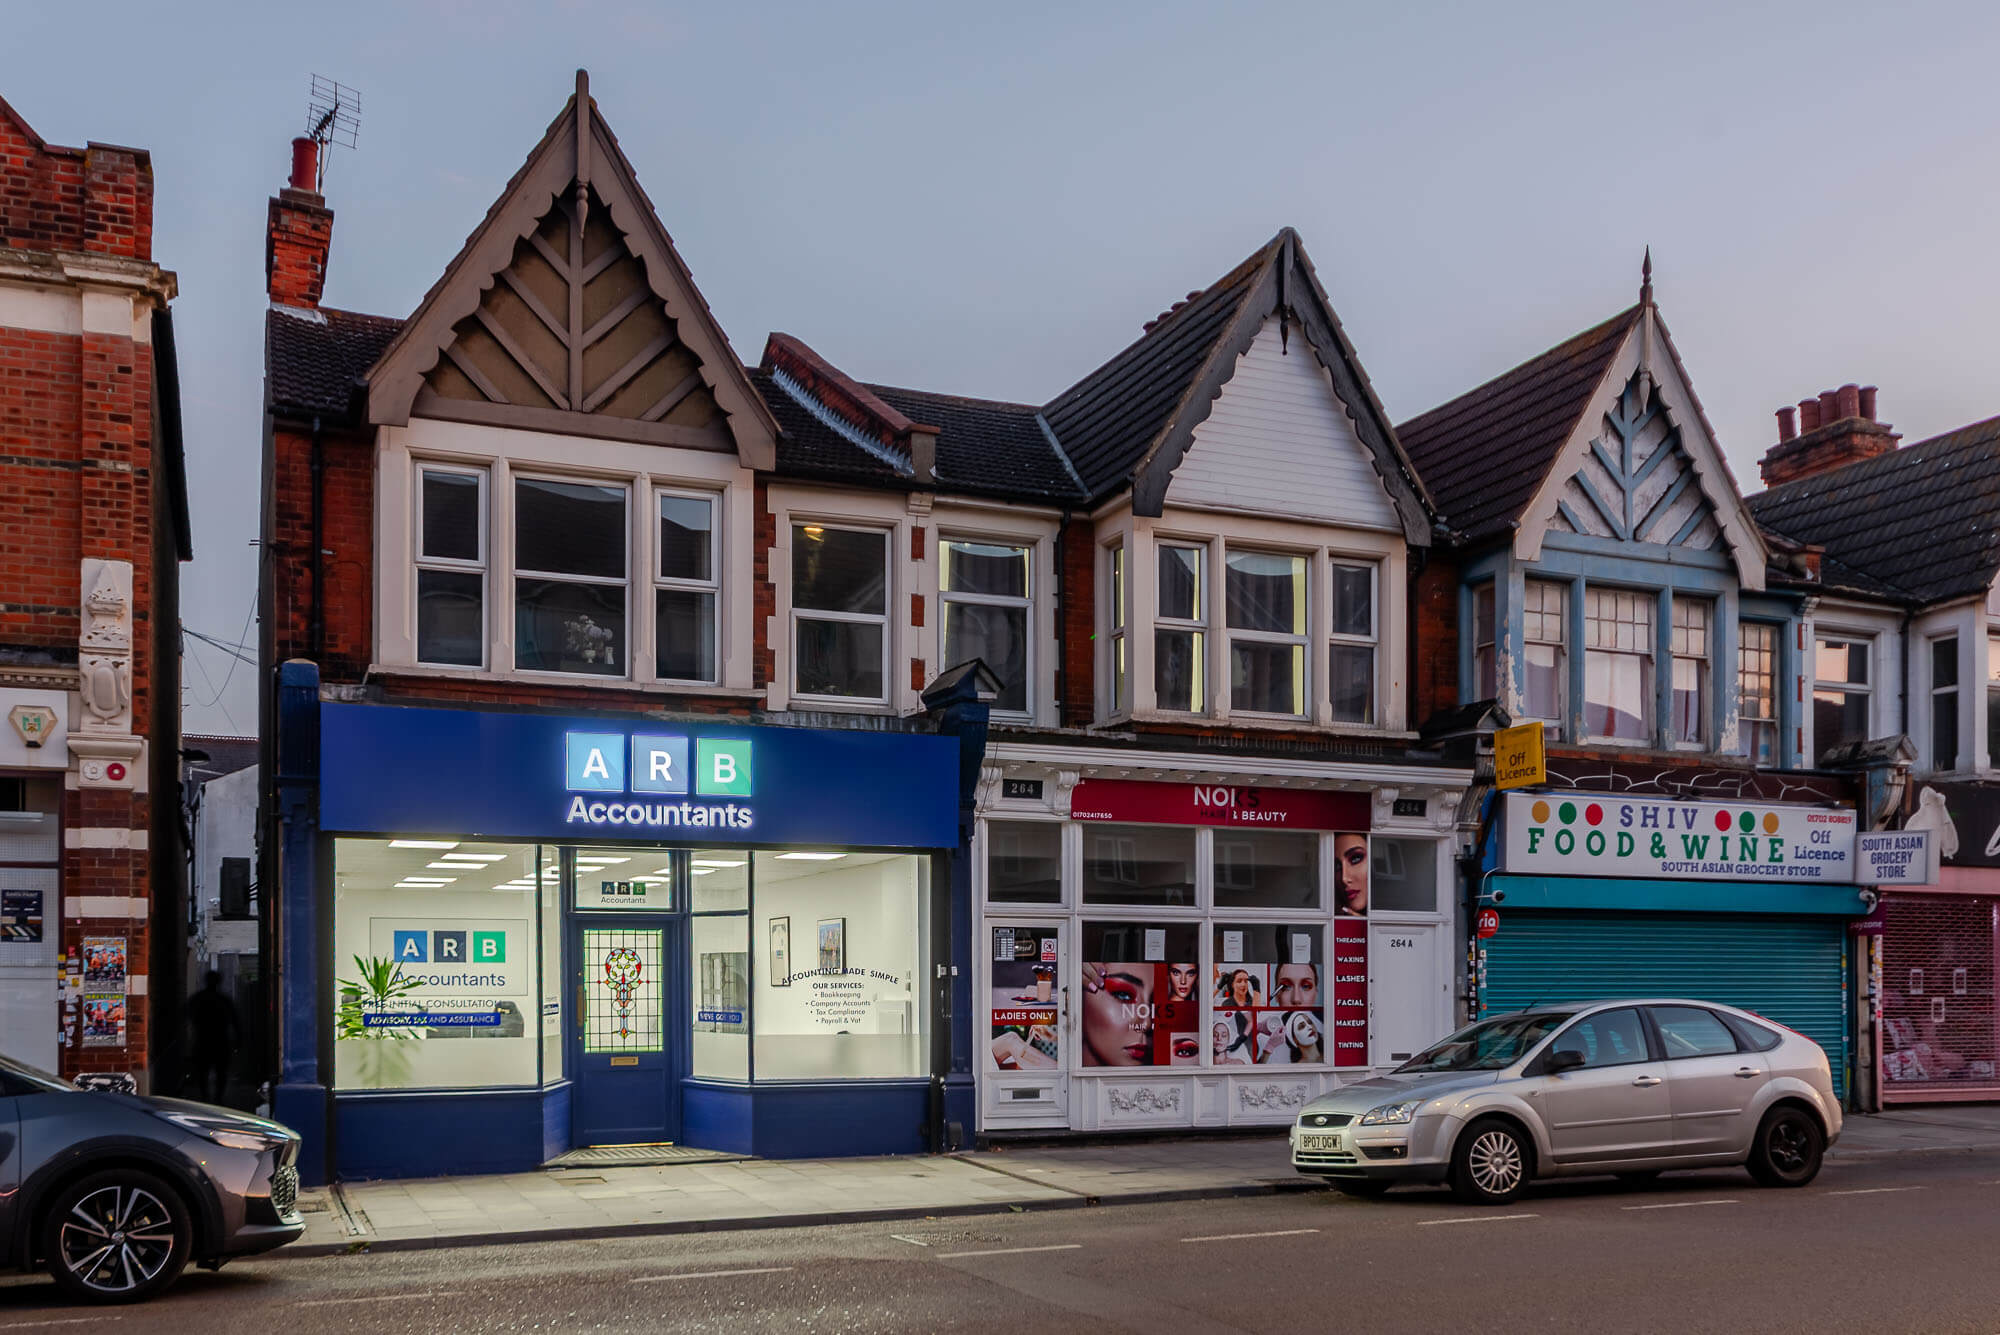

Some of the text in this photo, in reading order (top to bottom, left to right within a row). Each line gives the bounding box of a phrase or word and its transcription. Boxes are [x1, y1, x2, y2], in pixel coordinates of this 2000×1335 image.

[1509, 752, 1526, 767] Off
[1499, 766, 1536, 780] Licence
[1010, 784, 1034, 794] 264
[566, 796, 753, 828] Accountants
[1241, 810, 1287, 822] BEAUTY
[1619, 804, 1698, 831] SHIV
[1810, 830, 1832, 844] Off
[1862, 836, 1923, 851] SOUTH ASIAN
[1527, 827, 1785, 863] FOOD & WINE
[1794, 846, 1846, 861] Licence
[1870, 851, 1913, 865] GROCERY
[1661, 862, 1821, 877] SOUTH ASIAN GROCERY STORE
[1876, 866, 1906, 878] STORE
[600, 896, 646, 904] Accountants
[1390, 939, 1413, 948] 264 A
[394, 971, 506, 987] Accountants
[782, 967, 899, 985] ACCOUNTING MADE SIMPLE
[389, 1000, 423, 1009] INITIAL
[428, 1016, 447, 1024] AND
[449, 1015, 495, 1024] ASSURANCE
[994, 1012, 1054, 1020] LADIES ONLY
[1303, 1136, 1320, 1148] BP07
